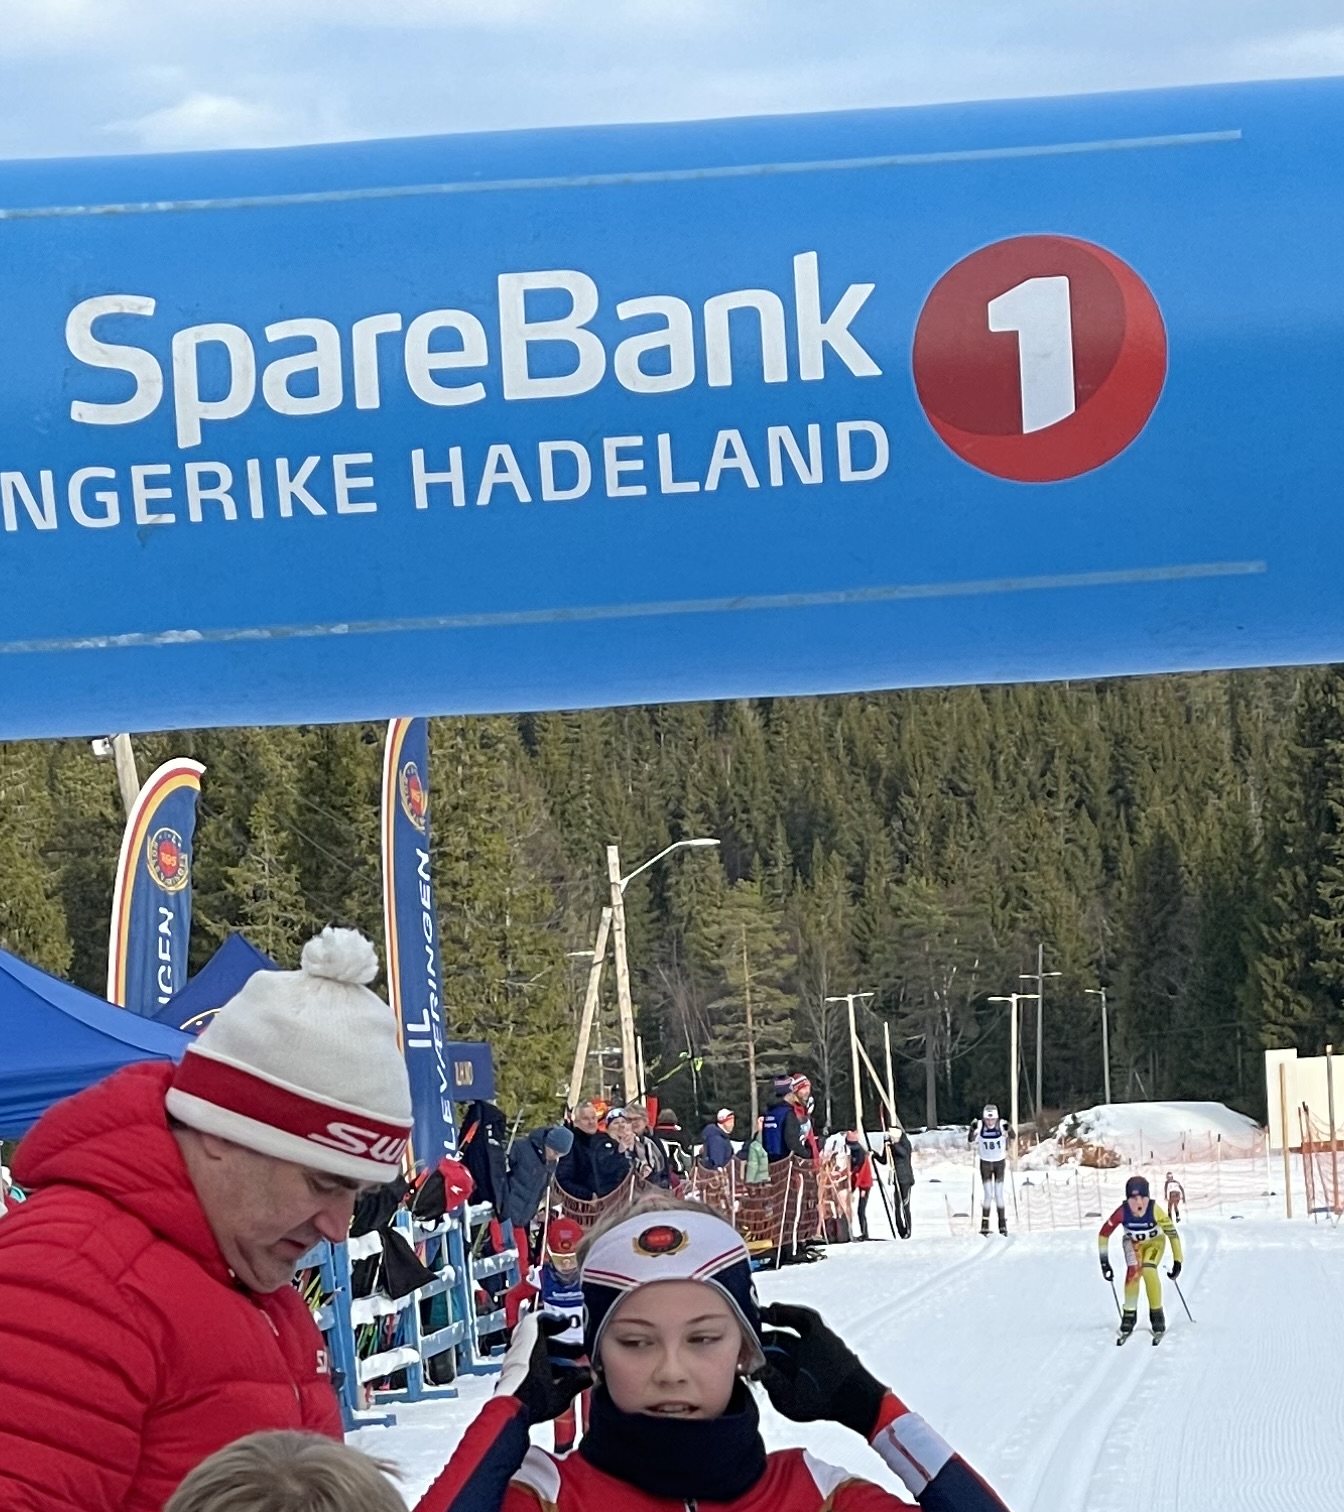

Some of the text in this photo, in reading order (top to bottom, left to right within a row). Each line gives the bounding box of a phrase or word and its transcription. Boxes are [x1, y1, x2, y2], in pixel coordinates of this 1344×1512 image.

[64, 250, 1077, 450] SpareBank 1
[411, 419, 891, 510] HADELAND
[406, 1008, 433, 1048] IL
[983, 1141, 1002, 1149] 181
